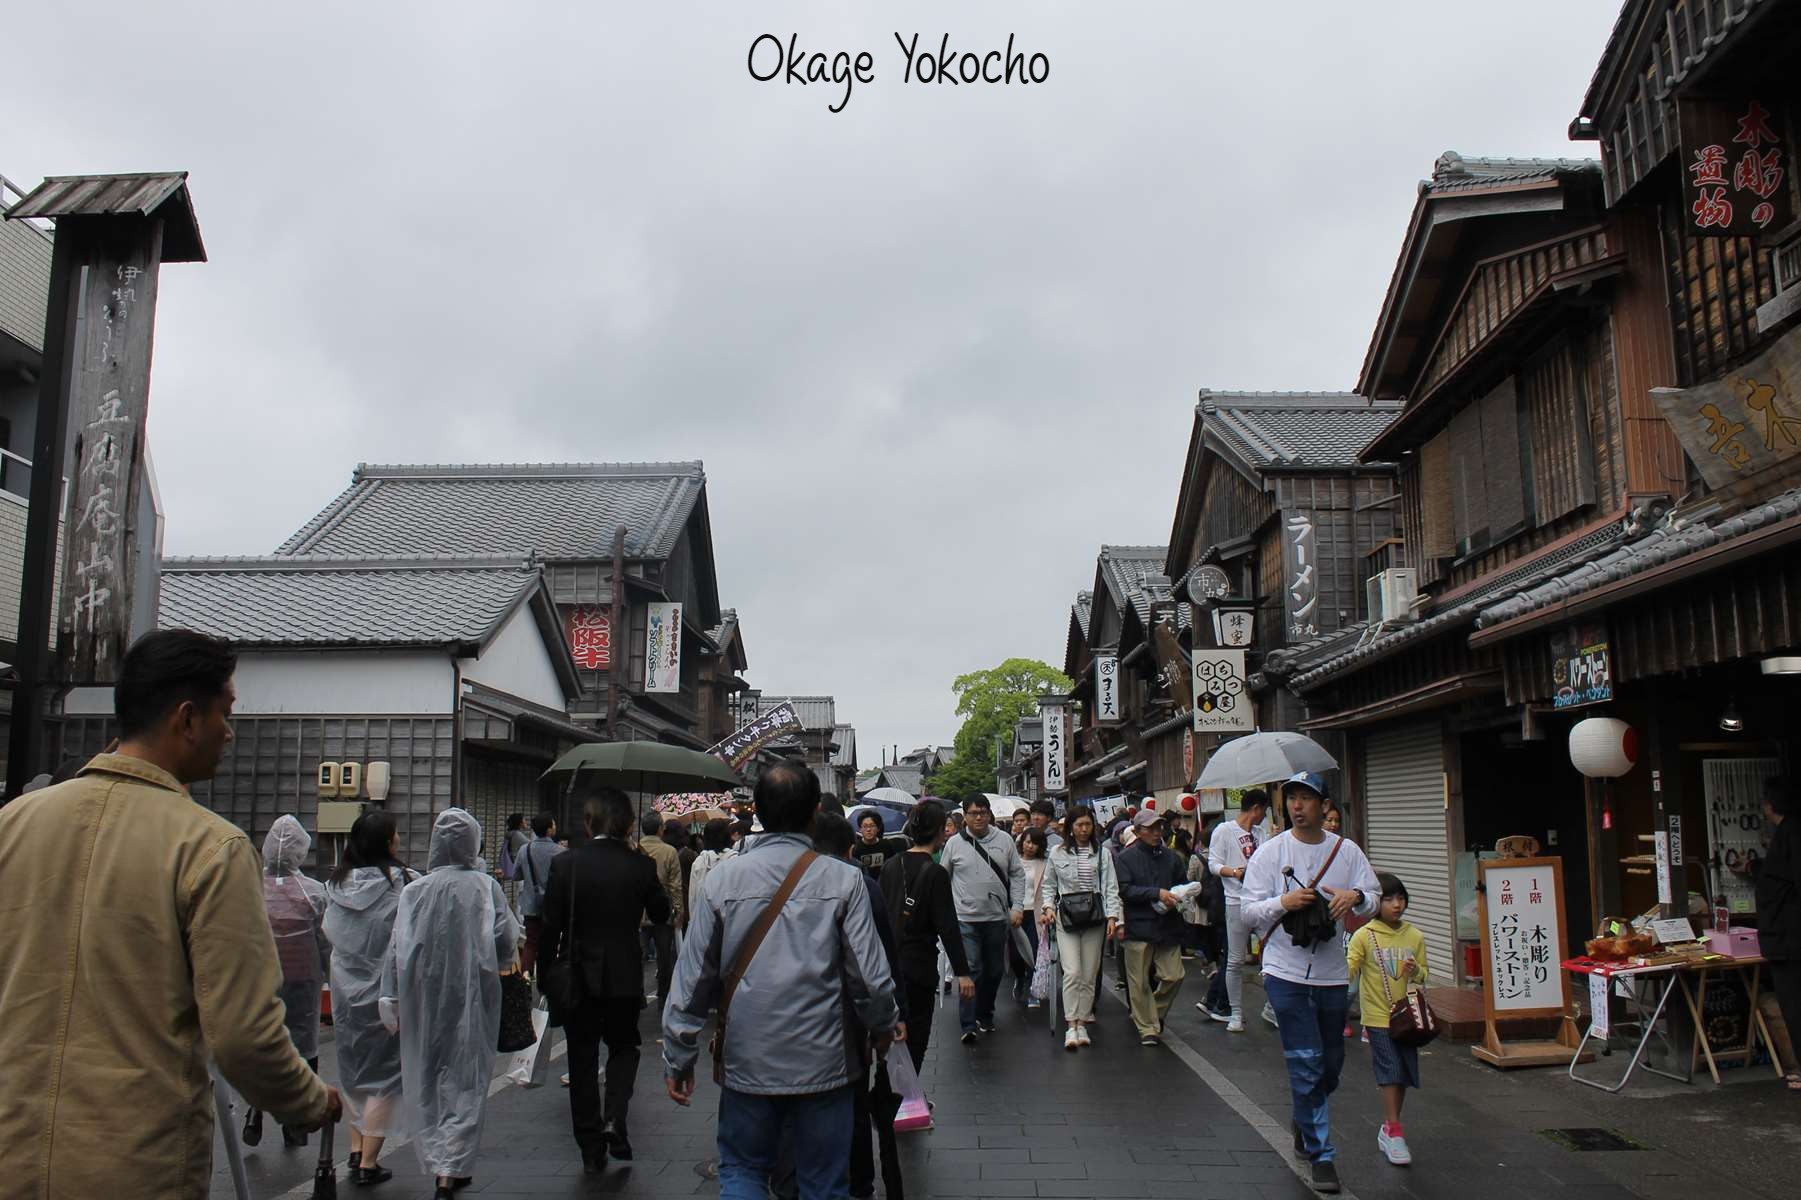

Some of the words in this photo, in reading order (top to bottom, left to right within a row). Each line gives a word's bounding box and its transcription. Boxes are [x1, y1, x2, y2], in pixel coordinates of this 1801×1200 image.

[1689, 144, 1733, 228] 置物
[1732, 102, 1784, 229] 木彫の
[1287, 515, 1316, 617] ラーメン
[571, 604, 611, 669] 松阪牛
[646, 628, 659, 689] ソフトクリーム
[1230, 614, 1245, 645] 蜂蜜
[1289, 622, 1319, 637] 市丸
[1102, 677, 1116, 716] まる天
[1501, 879, 1514, 906] 2階
[1529, 878, 1543, 905] 1階
[1501, 913, 1522, 999] パワーストーン
[1530, 924, 1550, 984] 木彫り
